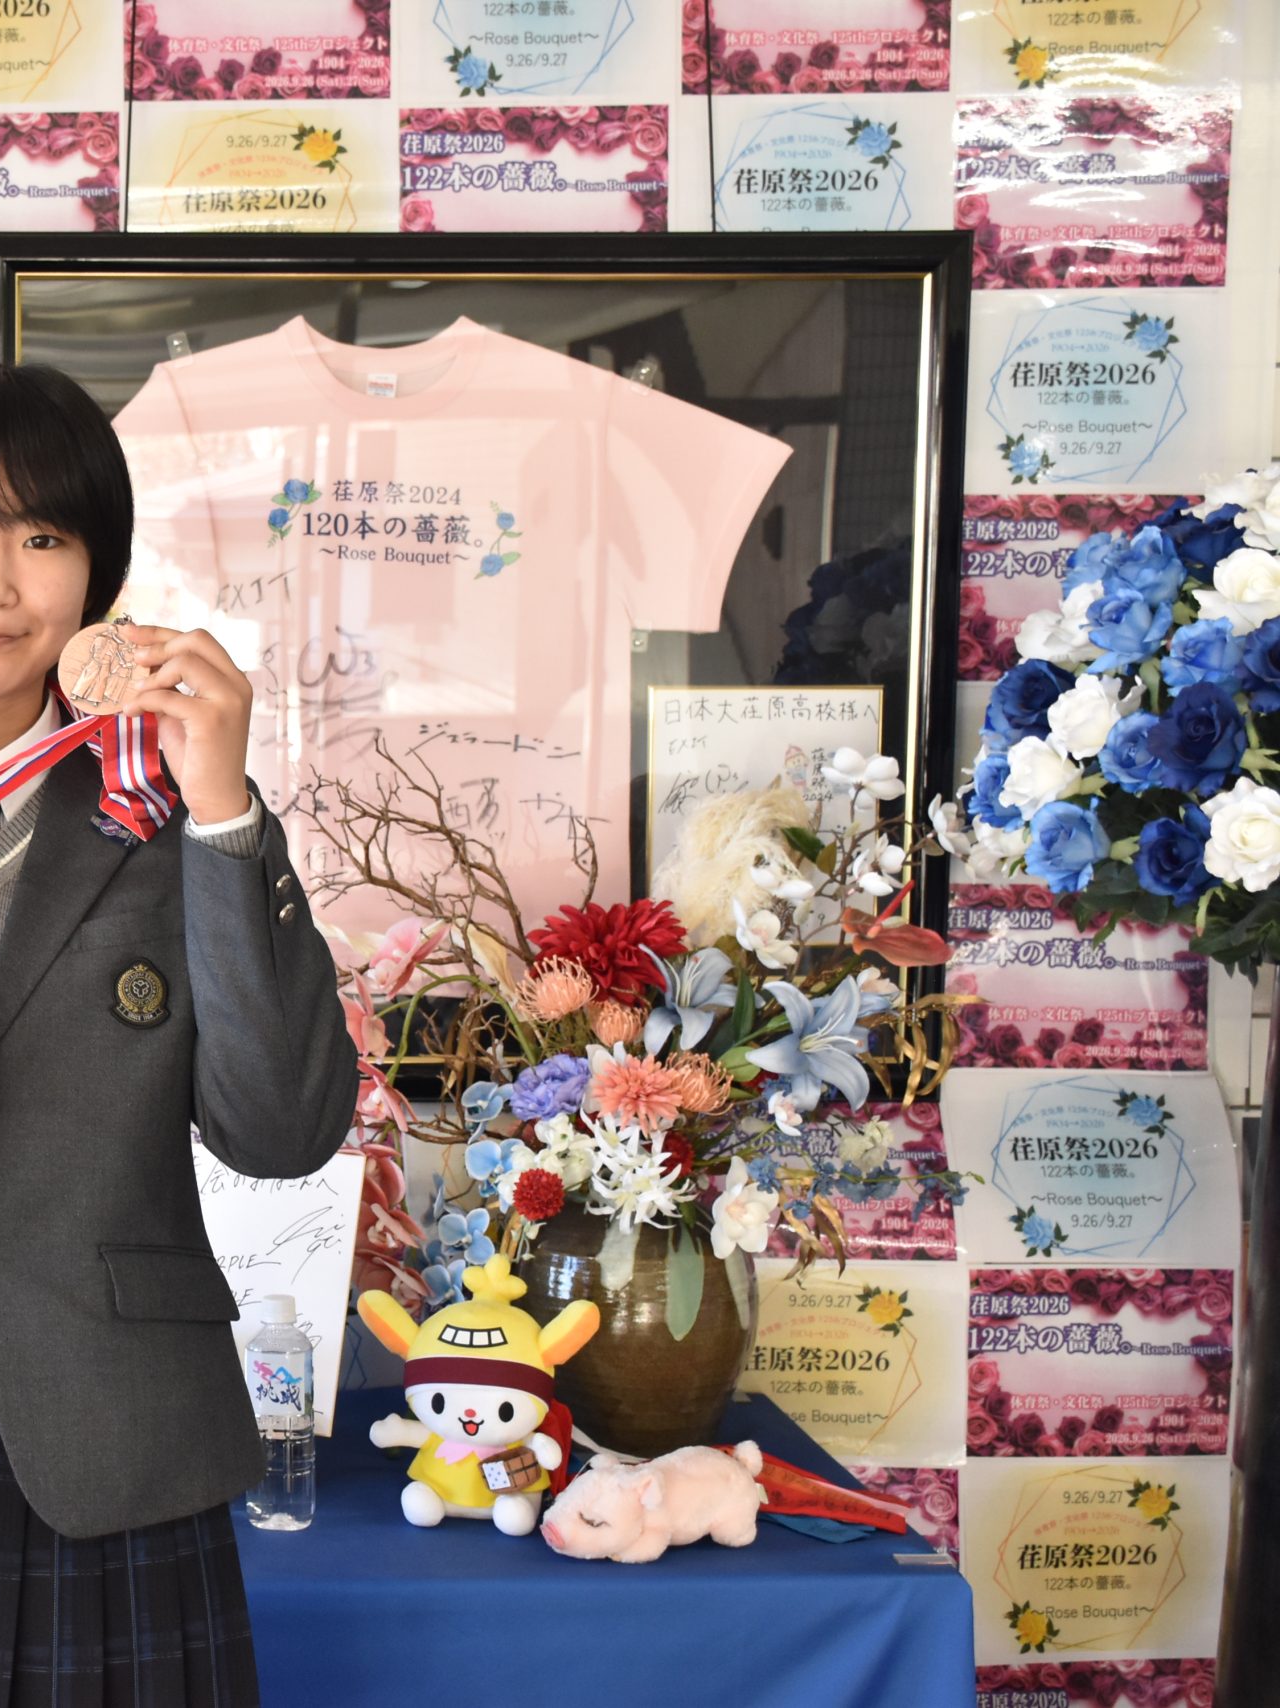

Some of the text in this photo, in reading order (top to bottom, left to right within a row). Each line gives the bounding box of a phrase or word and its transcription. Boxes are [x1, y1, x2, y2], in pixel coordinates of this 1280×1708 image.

[1048, 9, 1142, 25] 122本の薔薇。
[403, 133, 505, 155] 荏原祭2026
[401, 161, 567, 192] 122本の薔薇。
[733, 167, 879, 195] 荏原祭2026
[761, 196, 852, 212] 122本の薔薇。
[1010, 361, 1156, 388] 荏原祭2026
[1037, 390, 1130, 406] 122本の薔薇。
[332, 480, 462, 506] 荏原祭2024
[302, 510, 483, 548] 120本の薔薇。
[961, 521, 1058, 541] 荏原祭2026
[948, 910, 1052, 930] 荏原祭2026
[1010, 1136, 1158, 1162] 荏原祭2026
[1041, 1163, 1136, 1179] 122本の薔薇。
[971, 1295, 1069, 1316] 荏原祭2026
[969, 1324, 1132, 1355] 122本の薔薇。
[744, 1346, 890, 1372] 荏原祭2026
[770, 1380, 864, 1396] 122本の薔薇。
[1017, 1543, 1158, 1570] 荏原祭2026
[1044, 1575, 1132, 1591] 122本の薔薇。
